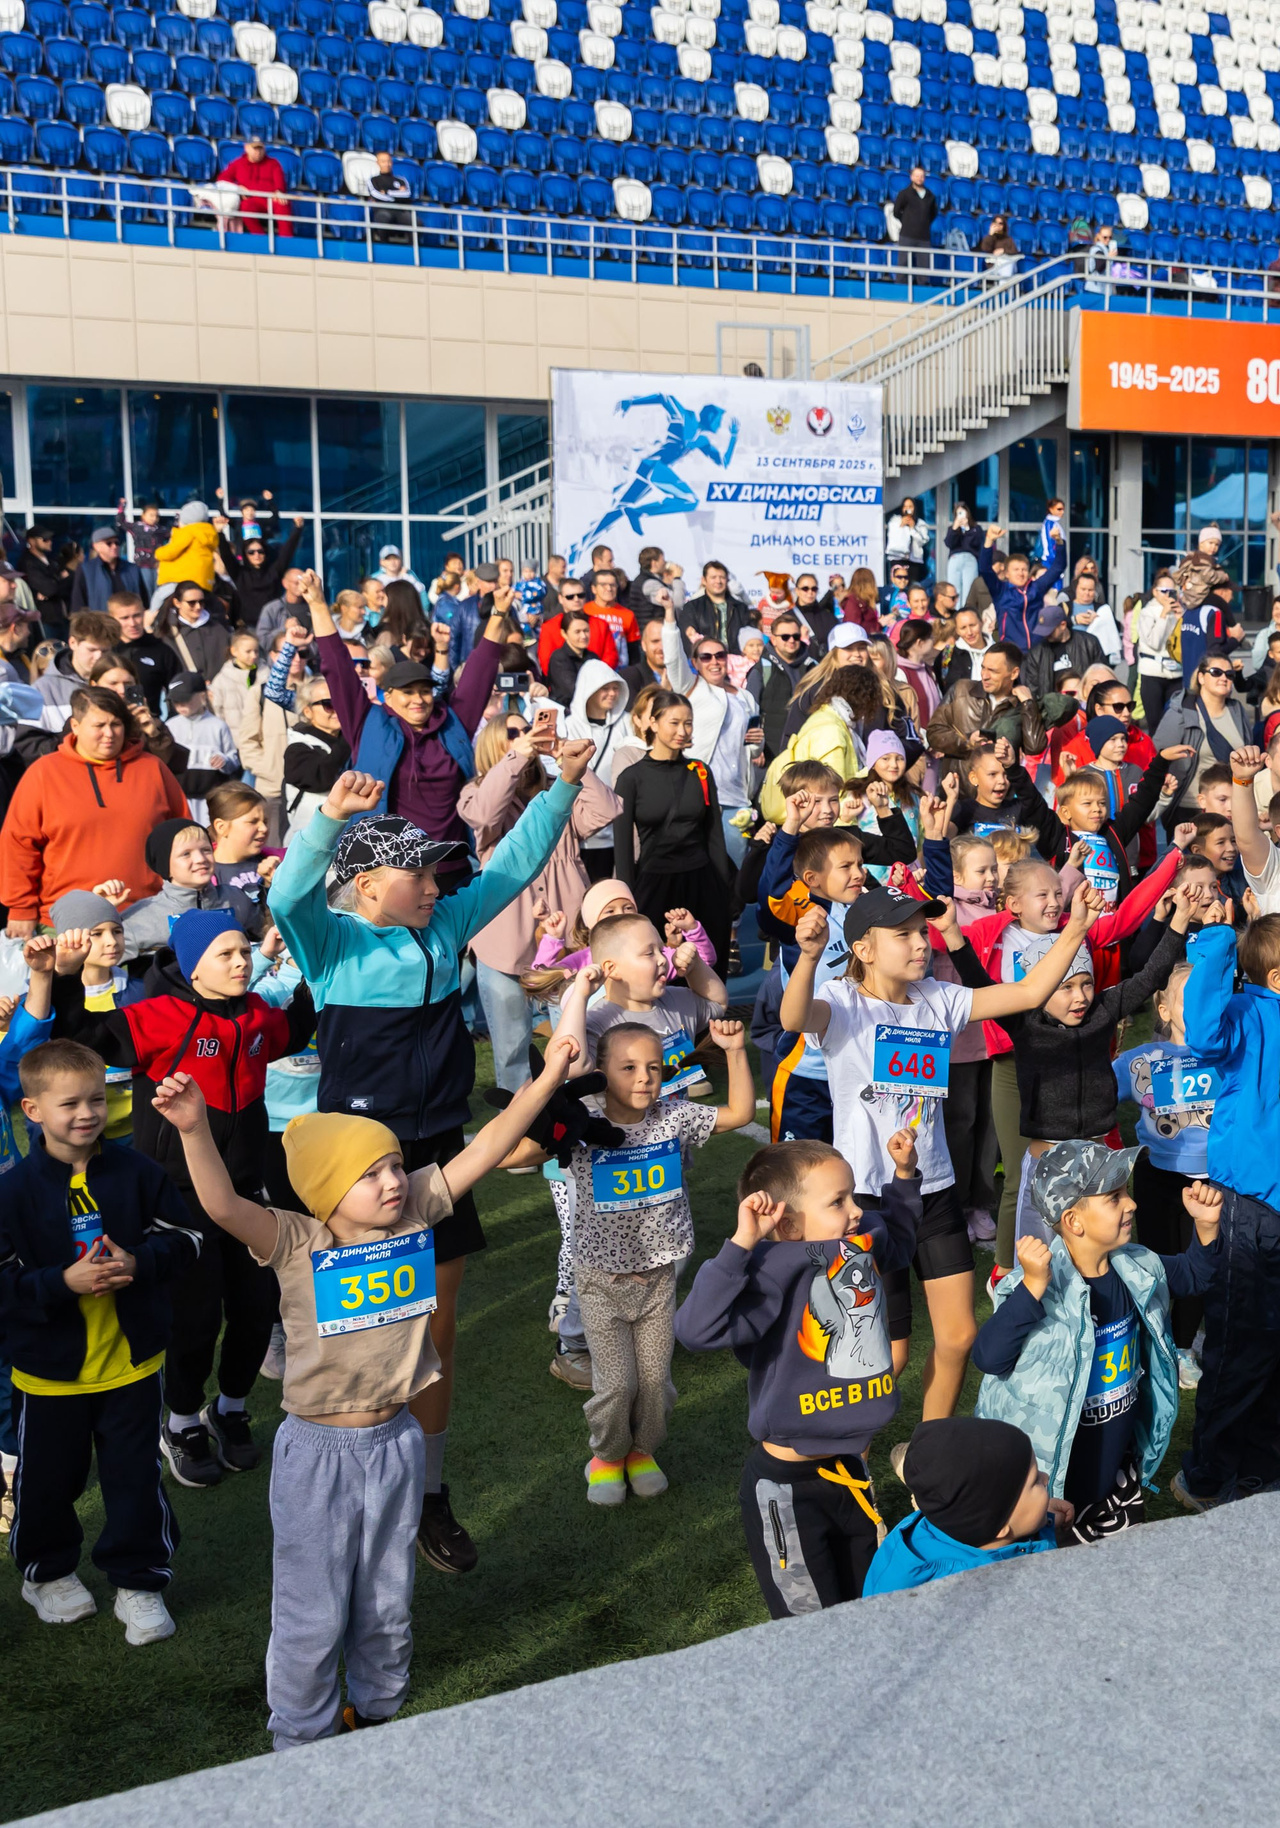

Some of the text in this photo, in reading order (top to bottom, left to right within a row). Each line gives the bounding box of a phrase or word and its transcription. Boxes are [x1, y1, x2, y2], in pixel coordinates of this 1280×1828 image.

[757, 457, 769, 467] 13
[772, 457, 835, 469] СЕНТЯБРЯ
[839, 460, 866, 470] 2025
[710, 484, 877, 503] XV ДИНАМОВСКАЯ
[767, 504, 820, 519] МИЛЯ
[750, 535, 868, 547] ДИНАМО БЕЖИТ
[793, 554, 868, 566] ВСЕ БЕГУТ!
[197, 1038, 219, 1057] 19
[888, 1051, 936, 1079] 648
[611, 1144, 663, 1157] ДИНАМОВСКАЯ
[629, 1153, 649, 1161] МИЛЯ
[612, 1165, 665, 1195] 310
[341, 1237, 410, 1258] ДИНАМОВСКАЯ
[365, 1250, 391, 1261] МИЛЯ
[340, 1265, 415, 1310] 350
[799, 1373, 893, 1416] ВСЕ В ПО
